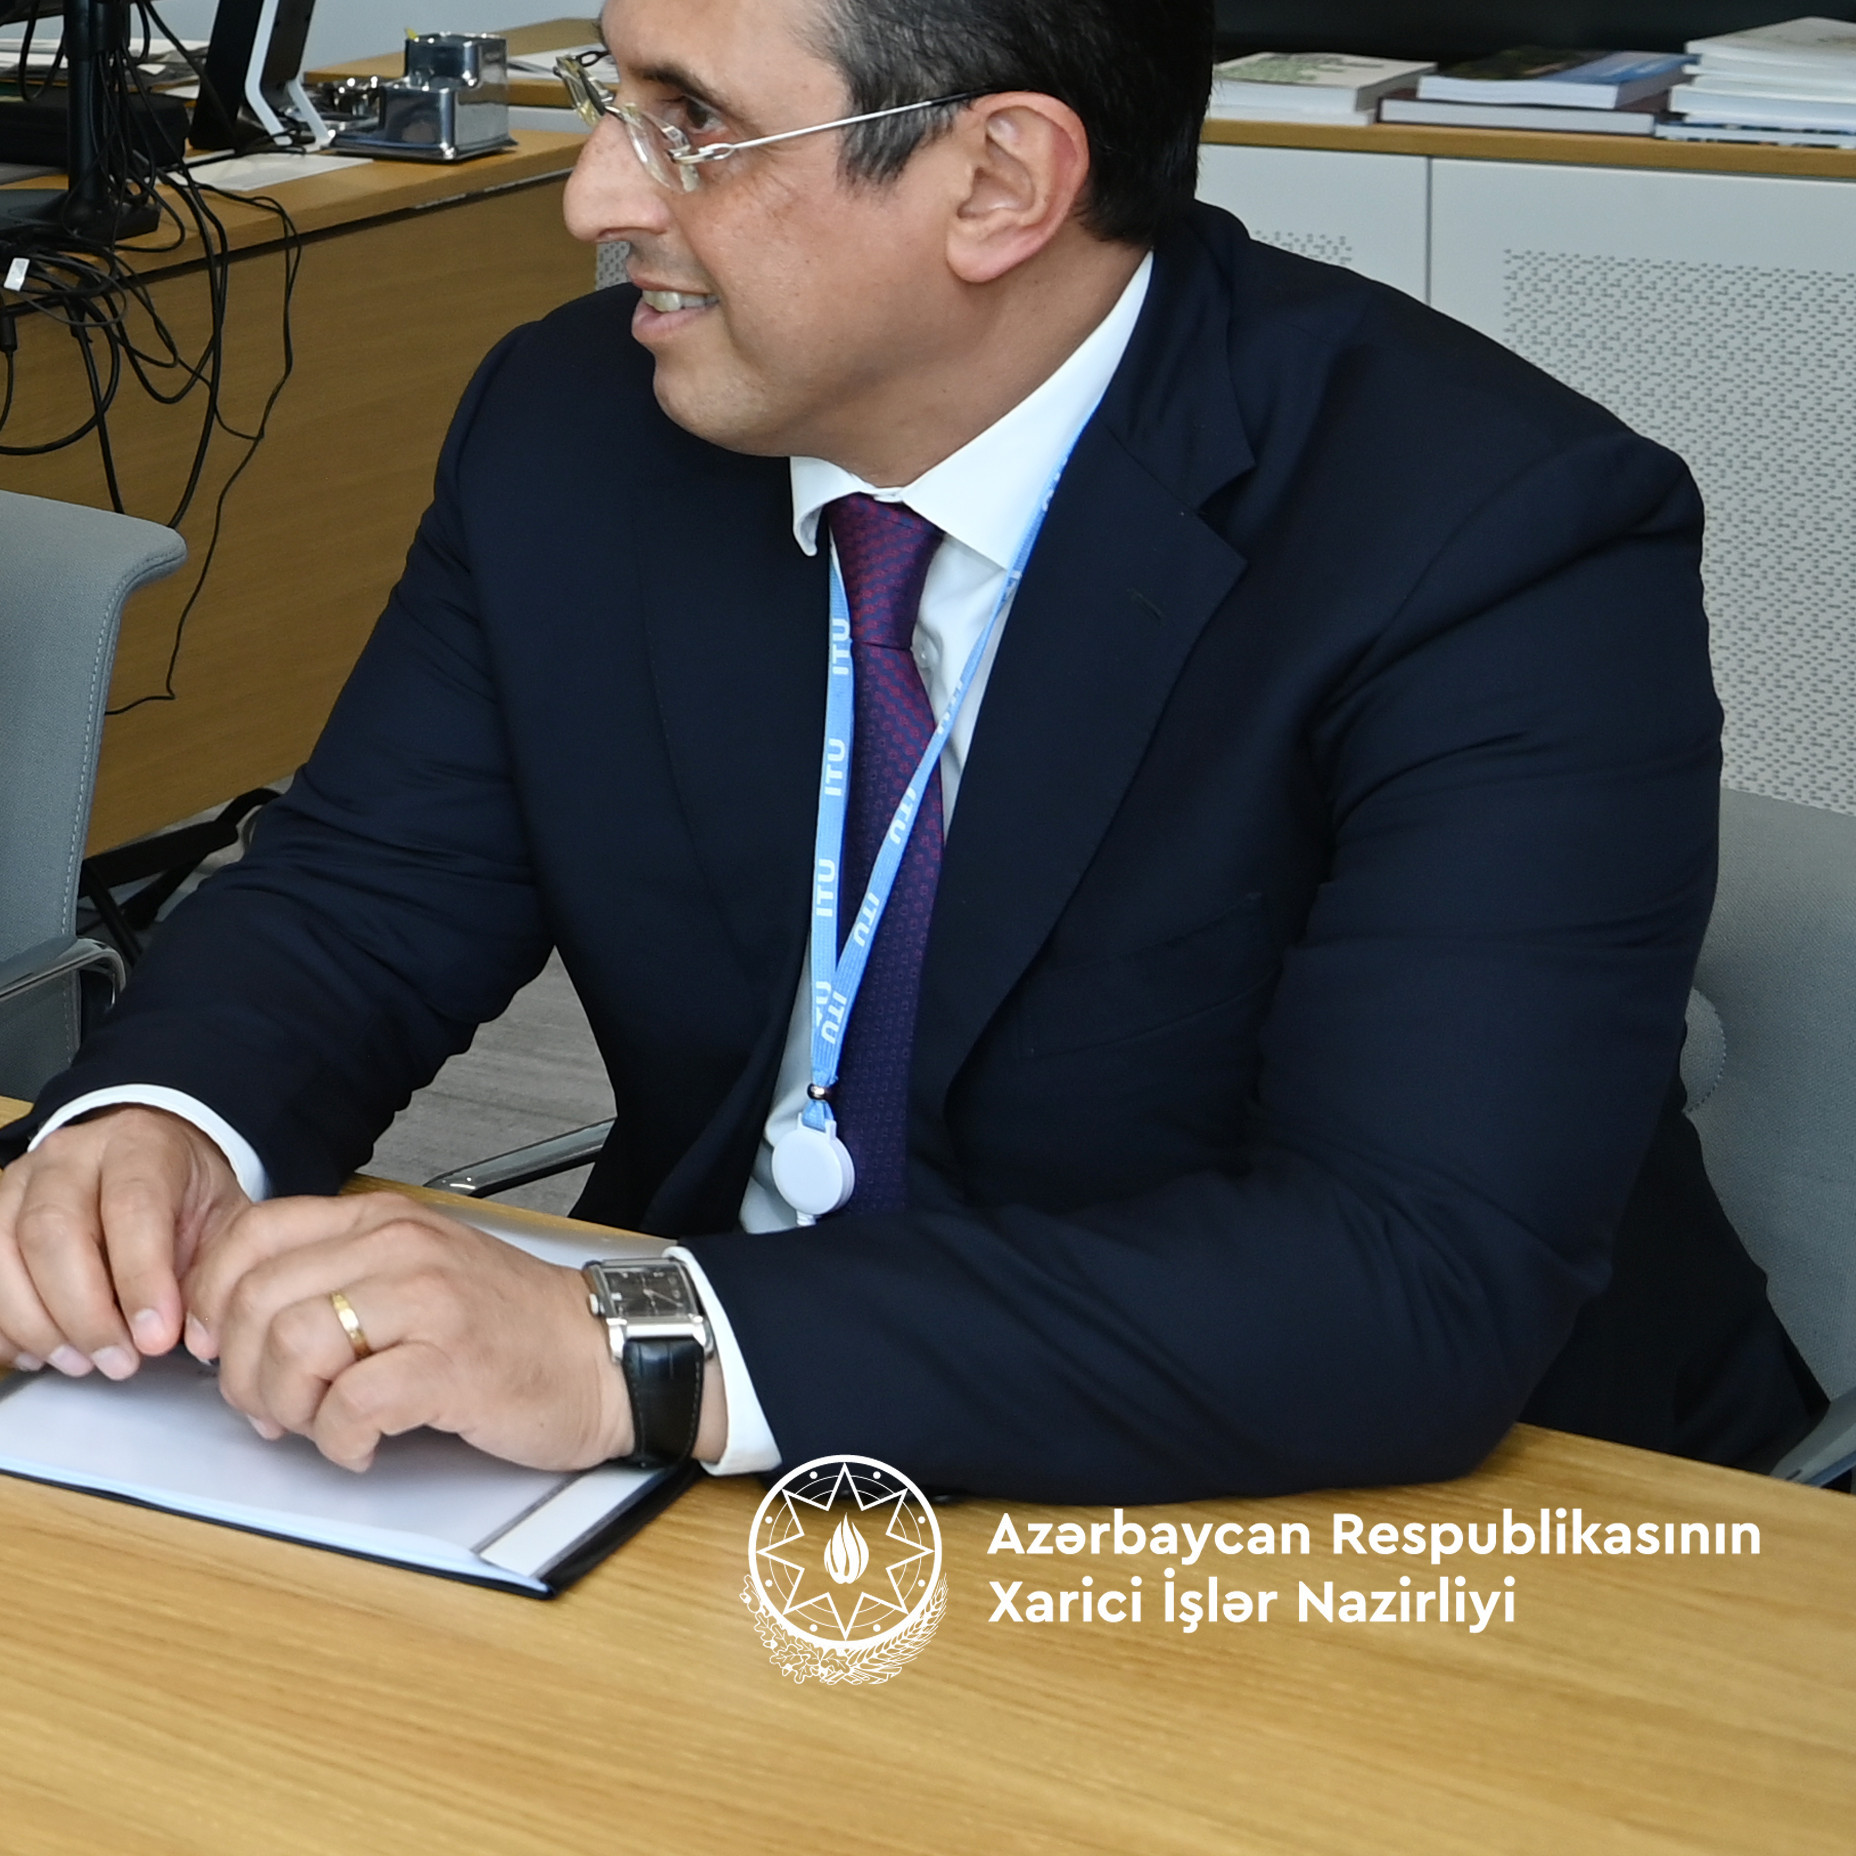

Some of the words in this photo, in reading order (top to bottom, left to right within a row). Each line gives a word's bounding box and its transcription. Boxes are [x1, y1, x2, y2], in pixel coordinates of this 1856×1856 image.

[832, 617, 850, 675] ITU
[825, 738, 846, 796] ITU
[815, 858, 837, 917] ITU
[854, 893, 879, 947] ITU
[815, 980, 833, 1028] TU
[820, 992, 847, 1045] ITU
